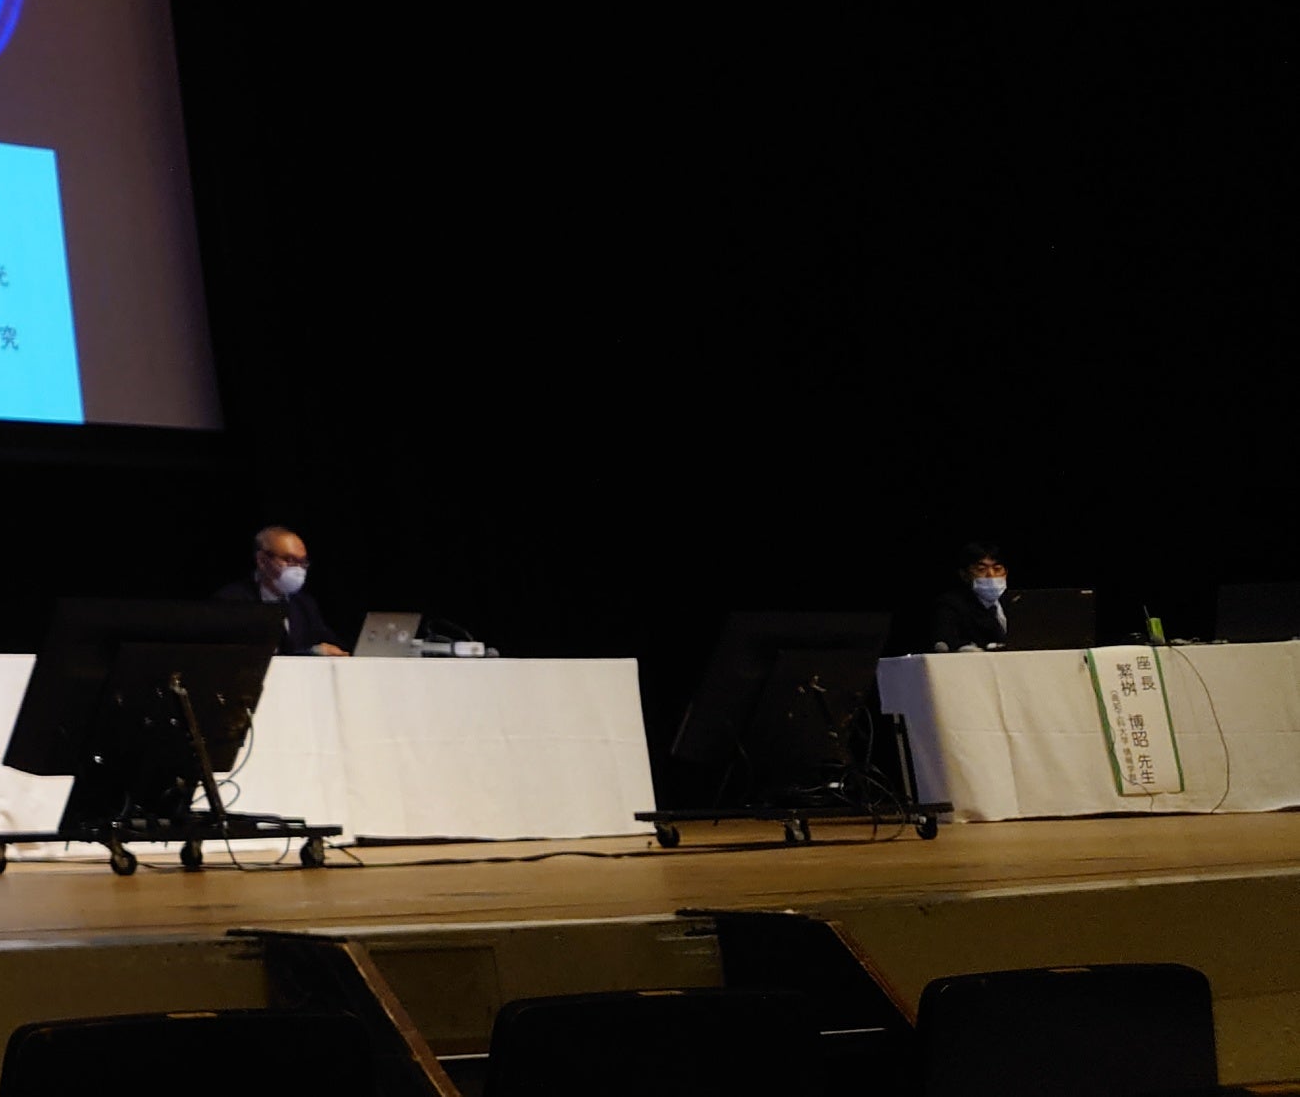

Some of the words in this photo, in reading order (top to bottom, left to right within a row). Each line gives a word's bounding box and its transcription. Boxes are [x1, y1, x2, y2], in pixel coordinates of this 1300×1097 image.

[1136, 656, 1156, 691] 座長
[1128, 713, 1149, 748] 博昭
[1138, 754, 1155, 785] 先生
